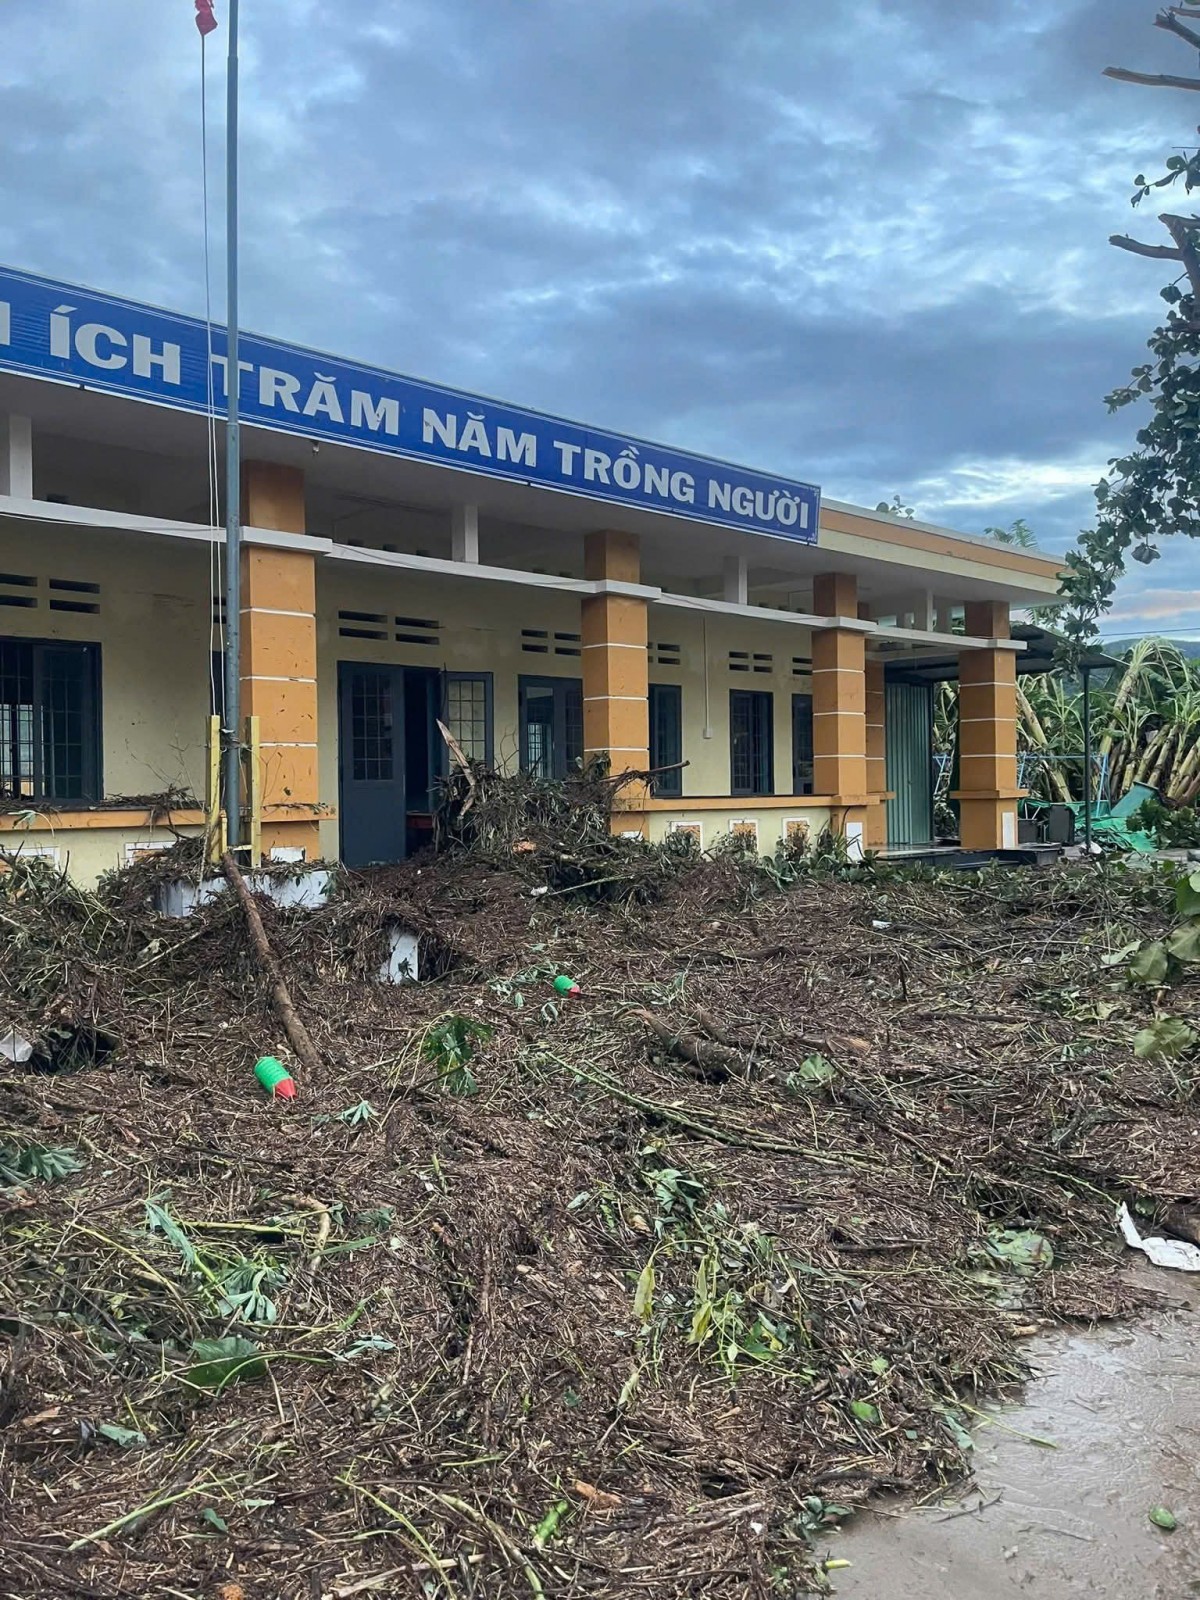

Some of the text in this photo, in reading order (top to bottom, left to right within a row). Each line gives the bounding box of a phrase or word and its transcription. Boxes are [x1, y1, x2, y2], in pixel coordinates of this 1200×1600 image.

[50, 306, 181, 385] ÍCH
[211, 355, 400, 435] TRĂM
[422, 408, 538, 467] NĂM
[553, 441, 696, 505] TRỒNG
[708, 480, 810, 529] NGƯỜI
